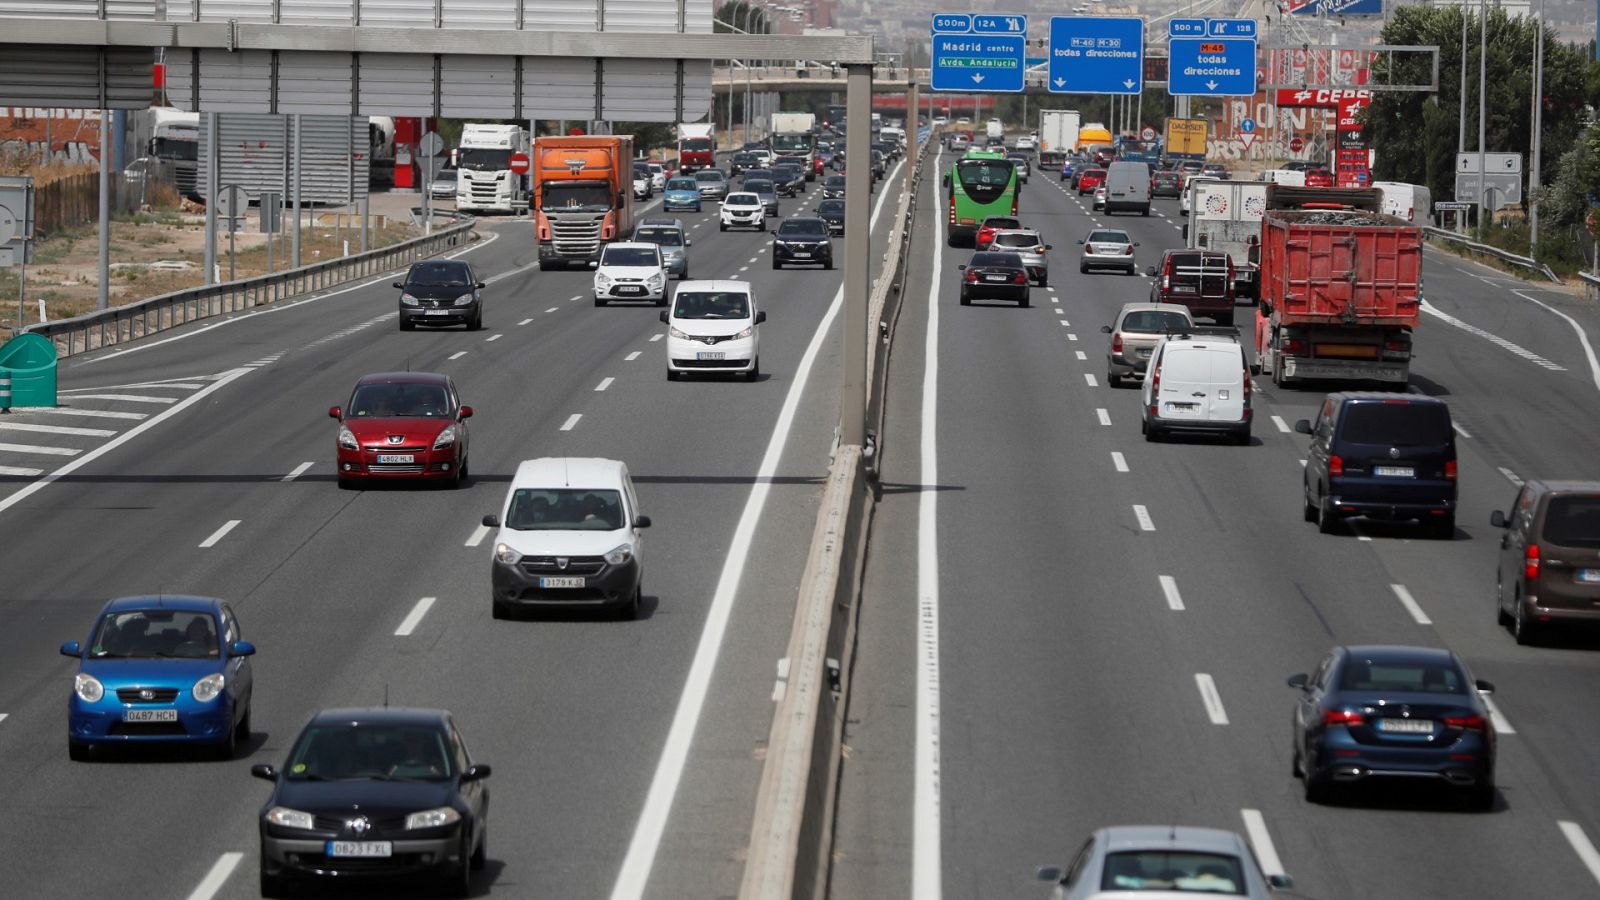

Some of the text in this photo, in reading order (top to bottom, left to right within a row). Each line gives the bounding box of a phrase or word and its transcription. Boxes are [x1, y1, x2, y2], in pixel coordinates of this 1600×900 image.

[937, 19, 966, 27] 500m
[977, 20, 996, 28] 12A
[942, 42, 982, 52] Madrid
[1200, 44, 1224, 52] M-45
[1054, 48, 1137, 58] todas direcciones
[1197, 55, 1227, 64] todas
[1183, 67, 1241, 76] direcciones
[128, 711, 175, 721] 0487 HCH
